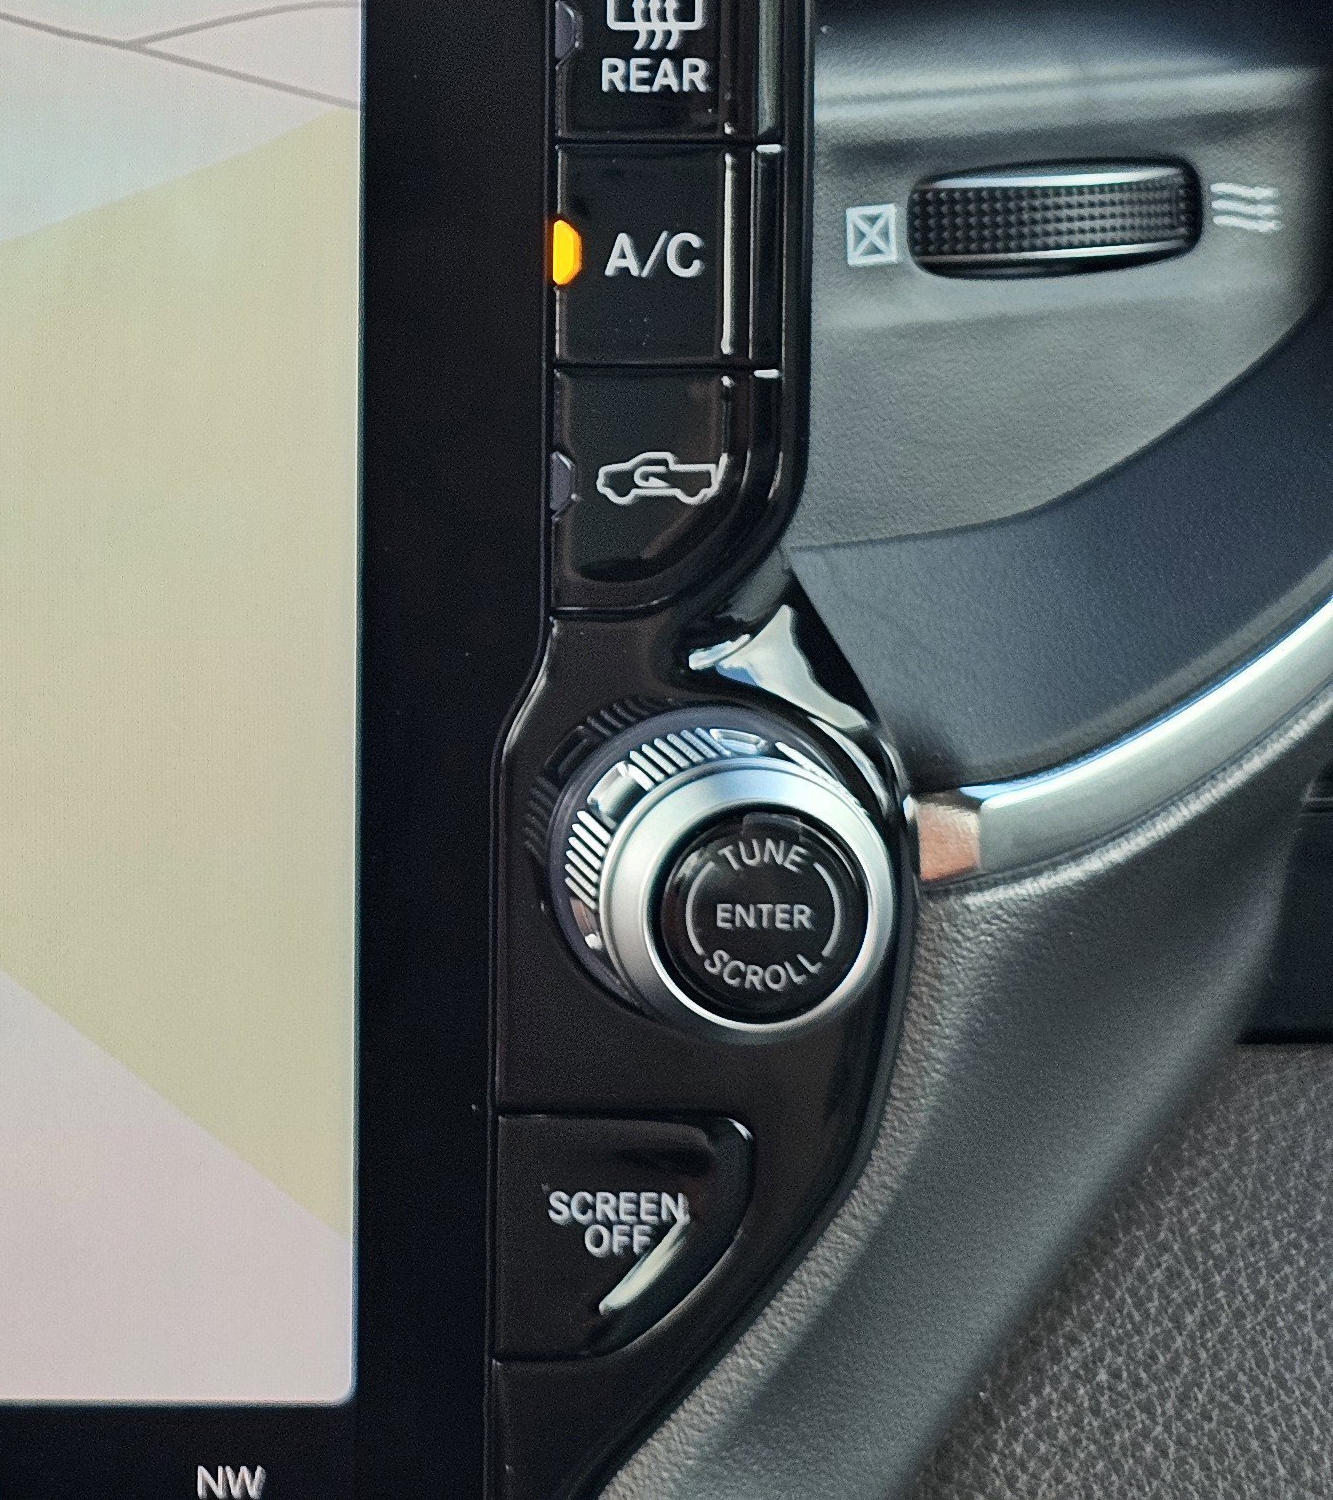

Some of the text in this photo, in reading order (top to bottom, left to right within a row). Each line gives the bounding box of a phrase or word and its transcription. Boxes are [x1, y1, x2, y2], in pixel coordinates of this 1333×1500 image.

[602, 58, 709, 93] REAR
[604, 231, 704, 279] A/C
[718, 838, 807, 872] TUNE
[716, 903, 813, 930] ENTER
[703, 949, 823, 992] SCROLL
[547, 1190, 689, 1225] SCREEN
[584, 1224, 653, 1257] OFF
[197, 1465, 267, 1500] NW
